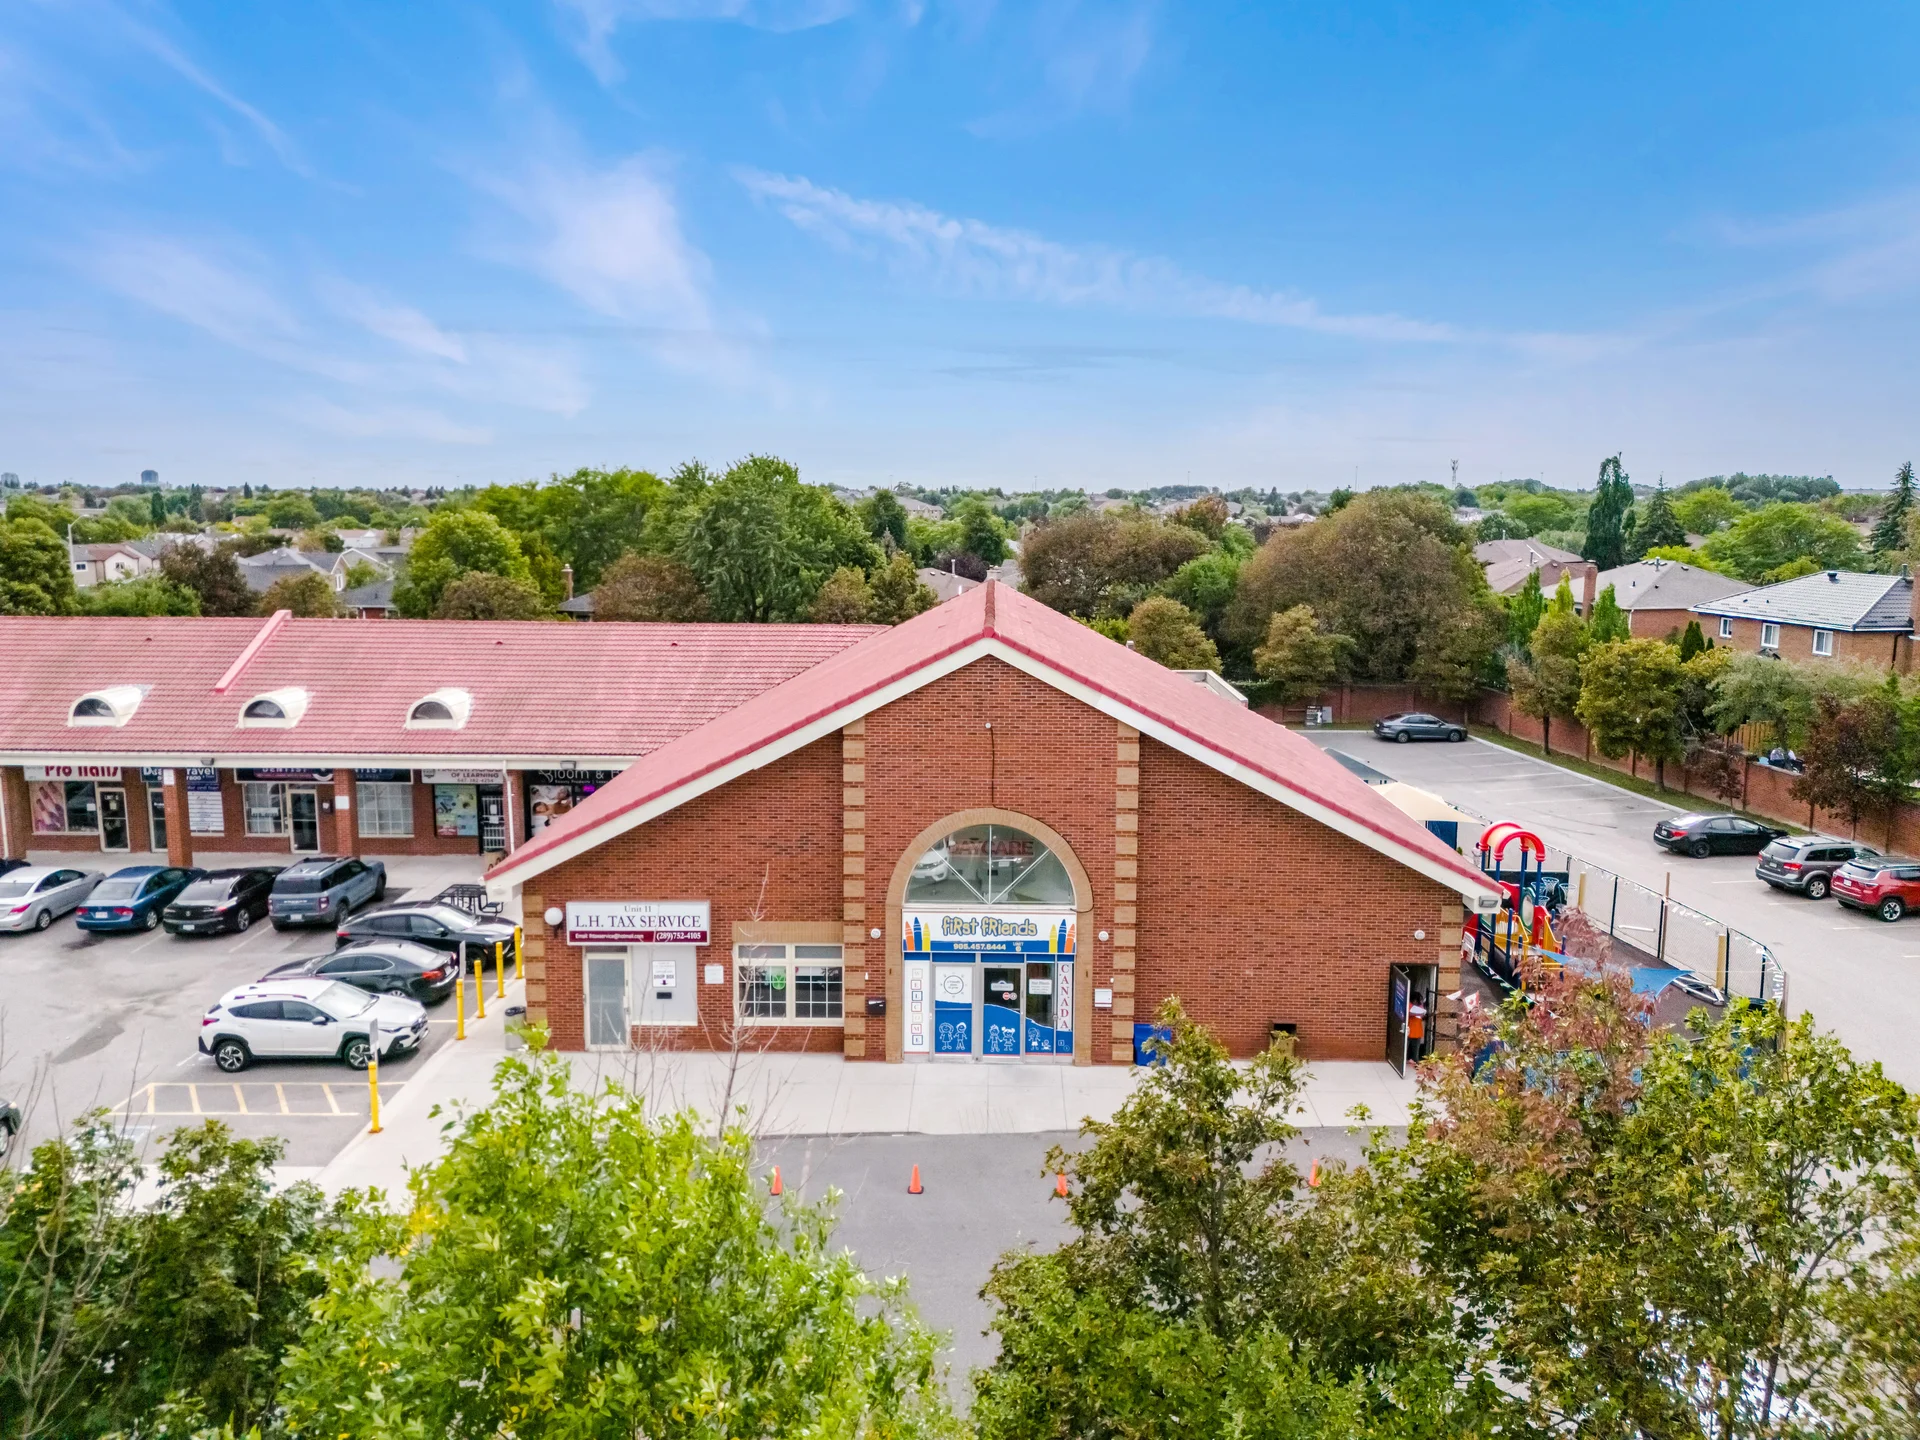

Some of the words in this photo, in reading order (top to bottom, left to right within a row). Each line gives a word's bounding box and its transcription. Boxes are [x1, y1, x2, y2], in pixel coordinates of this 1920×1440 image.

[186, 766, 215, 775] ravel
[595, 769, 604, 779] &
[575, 915, 604, 928] L.H.
[608, 915, 636, 928] TAX
[640, 915, 701, 928] SERVICE
[657, 932, 701, 940] (289)752-4105
[953, 943, 1006, 951] 905.457.8444
[1060, 964, 1070, 1029] CANADA
